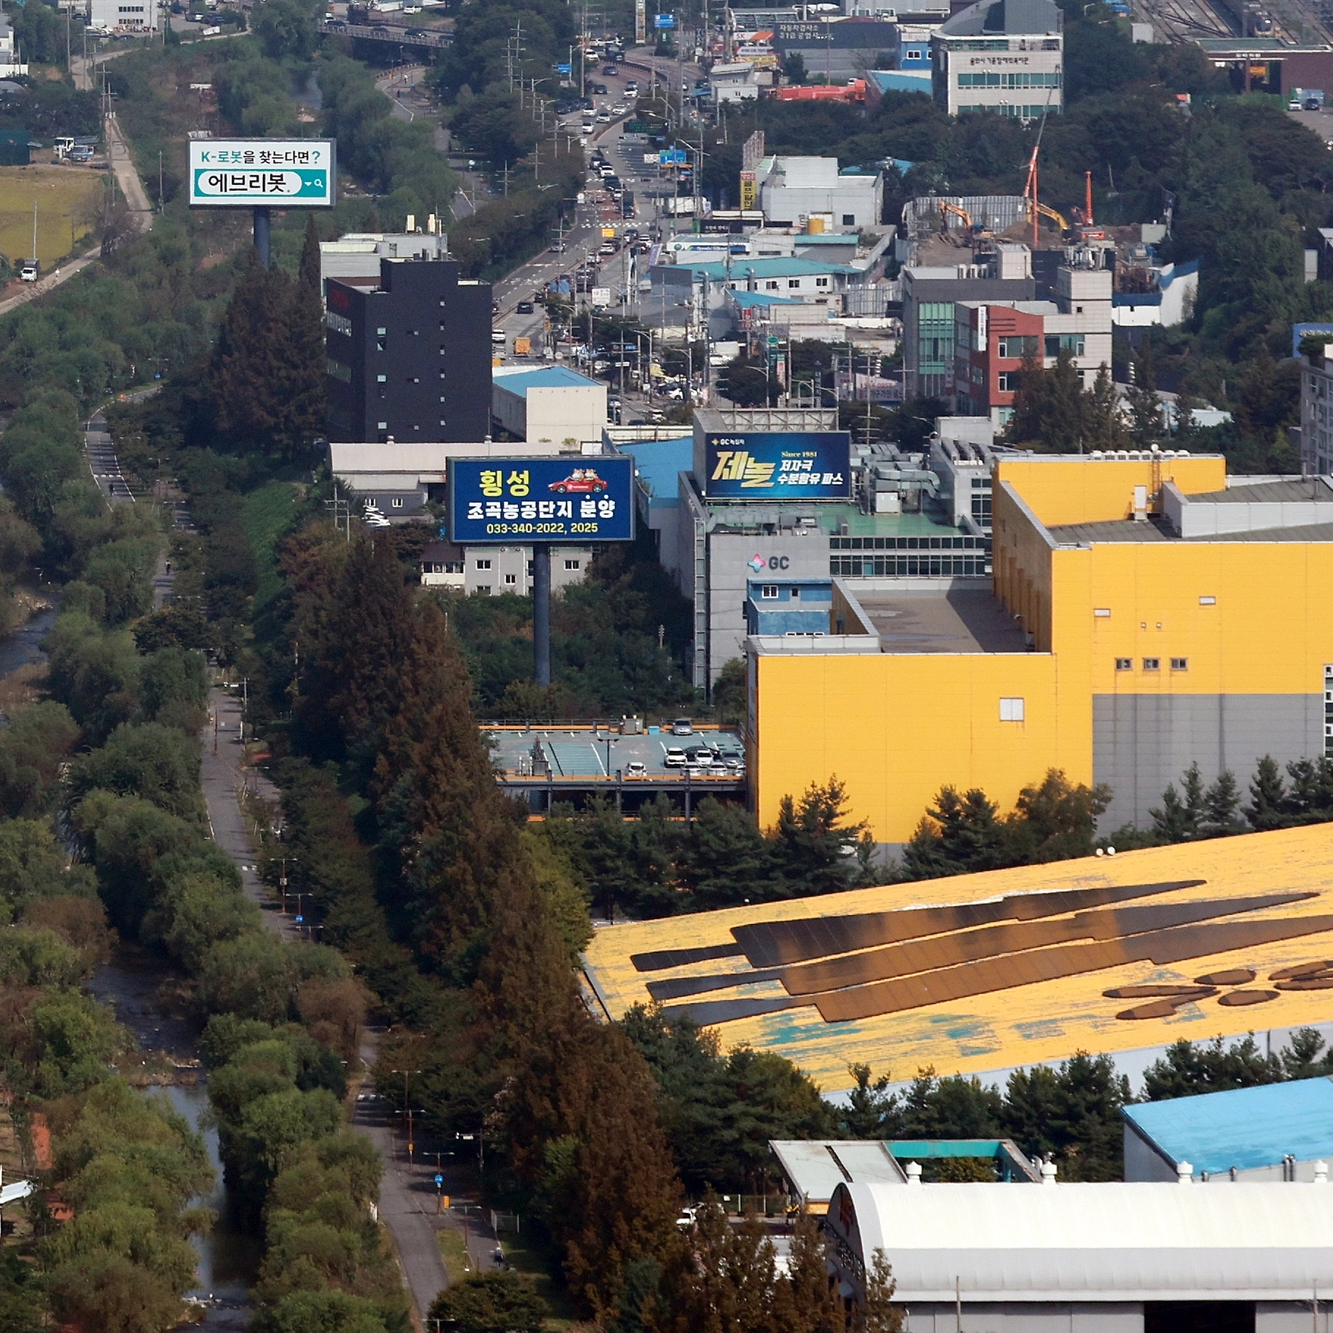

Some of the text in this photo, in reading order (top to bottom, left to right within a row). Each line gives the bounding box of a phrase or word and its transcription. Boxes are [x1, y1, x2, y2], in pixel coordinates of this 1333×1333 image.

[201, 150, 321, 166] K-로봇을 찾는다면?
[207, 173, 287, 193] 에브리봇
[712, 451, 776, 487] 제놀
[779, 459, 812, 472] 저자극
[479, 470, 530, 497] 횡성
[776, 473, 843, 485] 수분함유 파스
[467, 496, 615, 521] 조곡농공단지 분양
[487, 522, 598, 536] 033-340-2022, 2025
[768, 556, 790, 570] GC
